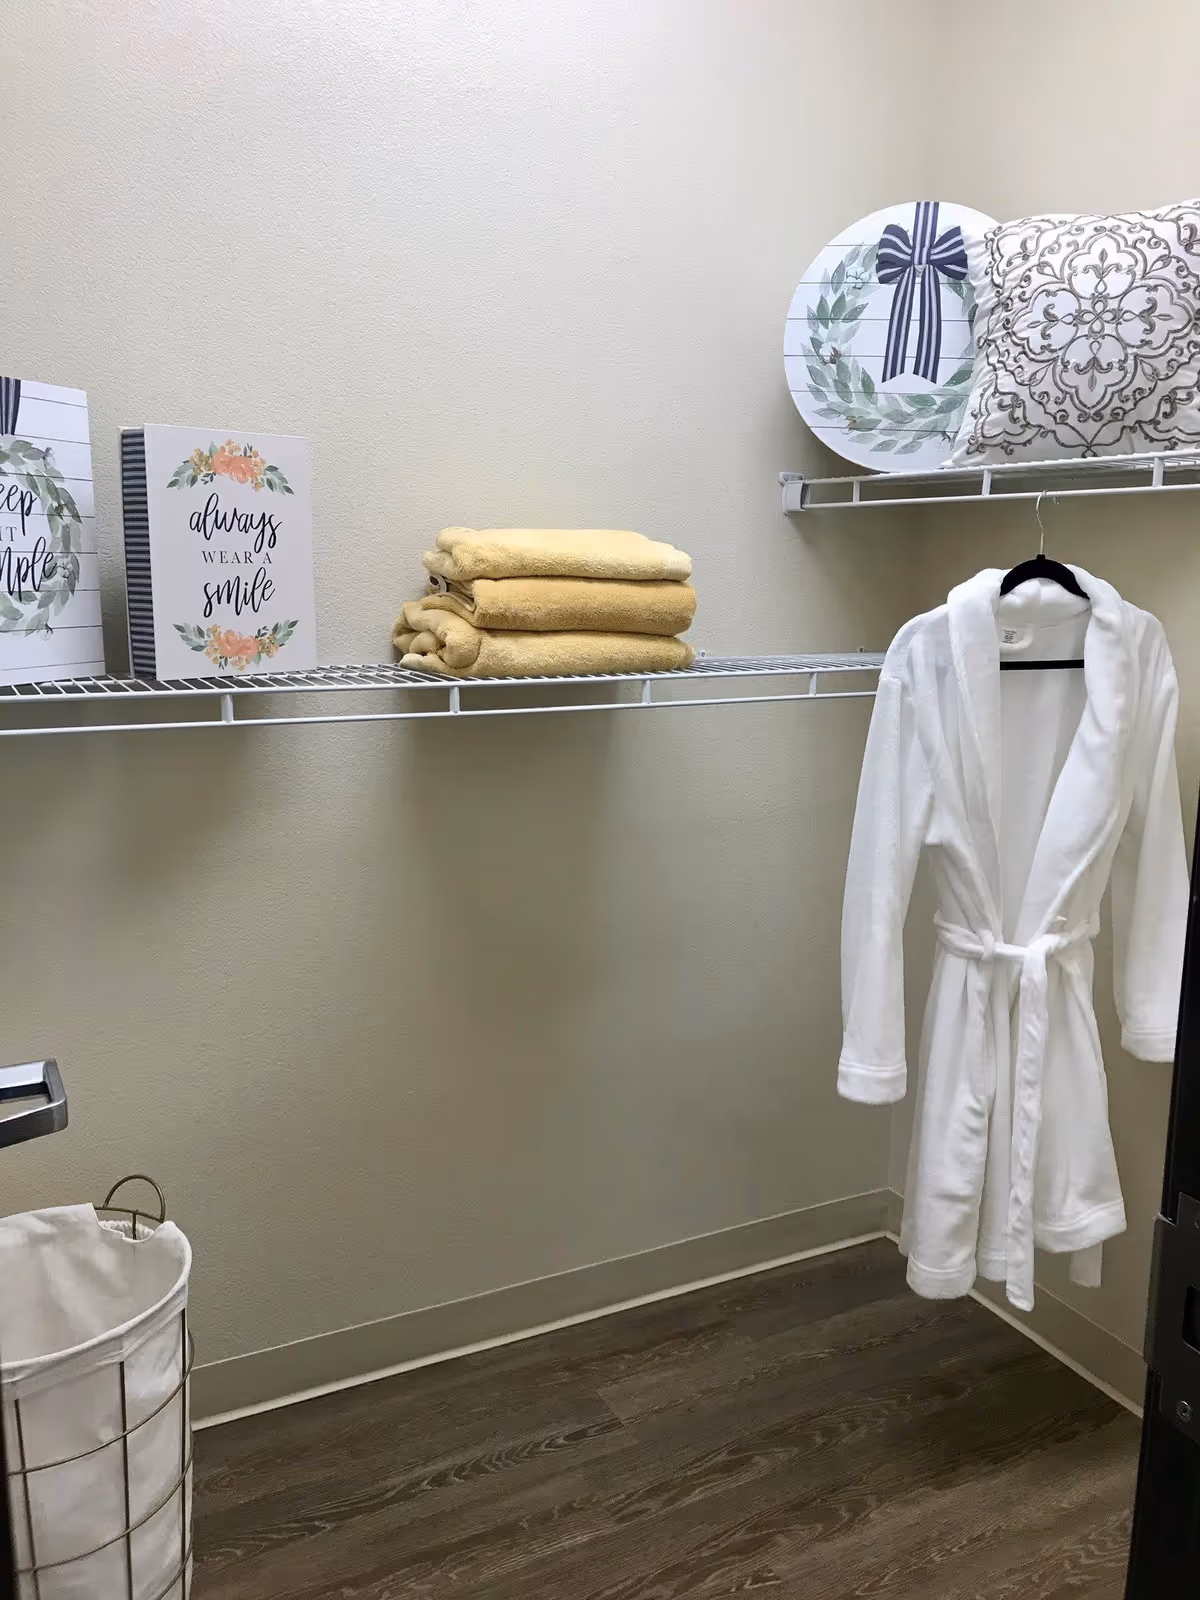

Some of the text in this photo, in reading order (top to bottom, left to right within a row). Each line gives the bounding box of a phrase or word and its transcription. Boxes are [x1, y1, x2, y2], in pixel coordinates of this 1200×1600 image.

[189, 492, 283, 554] always
[202, 550, 273, 564] WEAR A
[203, 566, 276, 618] smile
